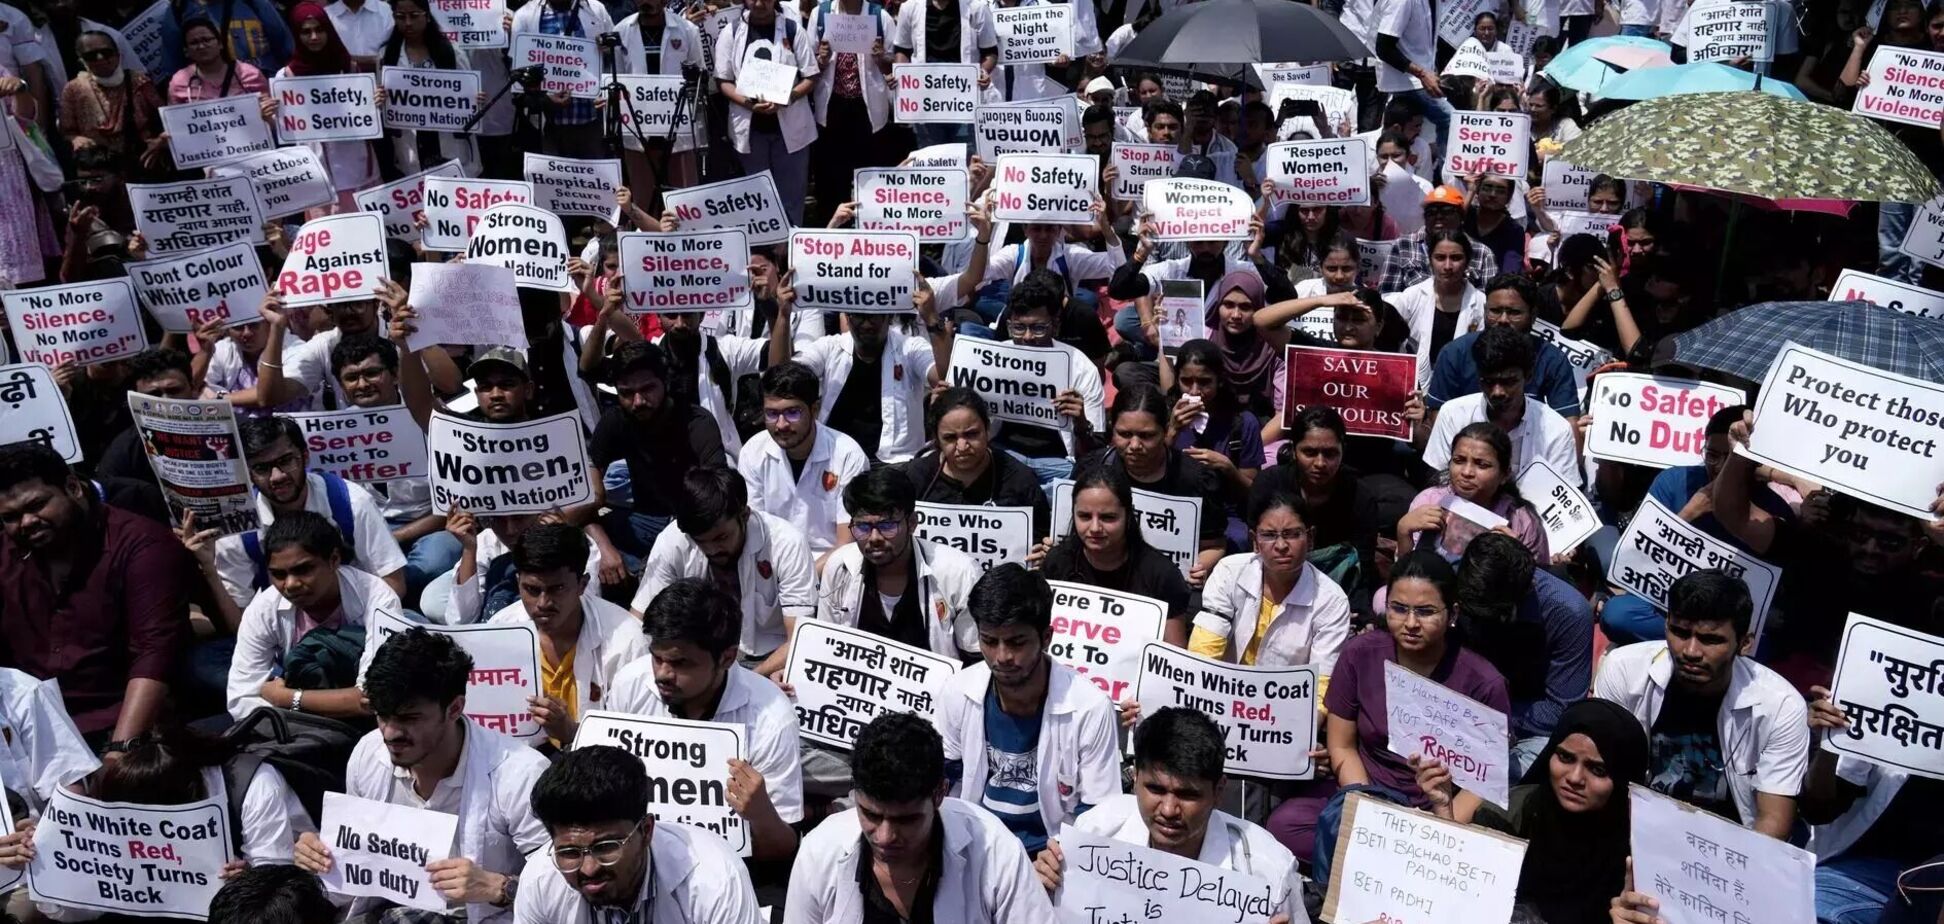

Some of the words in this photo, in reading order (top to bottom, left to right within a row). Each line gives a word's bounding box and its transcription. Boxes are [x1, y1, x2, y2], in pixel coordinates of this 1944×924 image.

[996, 11, 1045, 23] Reclaim
[1047, 9, 1064, 21] the
[1012, 22, 1049, 37] Night
[1694, 21, 1743, 36] राहणार
[531, 38, 553, 49] "No
[556, 40, 584, 52] More
[1007, 37, 1034, 47] Save
[1037, 35, 1056, 45] our
[527, 50, 588, 69] Silence,
[1004, 47, 1061, 61] Saviours
[1895, 54, 1918, 67] "No
[552, 67, 581, 78] More
[403, 74, 462, 92] "Strong
[901, 76, 920, 89] No
[924, 75, 972, 94] Safety,
[282, 90, 305, 106] No
[310, 87, 367, 106] Safety,
[388, 89, 477, 114] Women,
[1886, 85, 1905, 97] No
[1908, 89, 1943, 104] More
[191, 104, 235, 119] Justice
[900, 99, 919, 112] No
[923, 97, 974, 112] Service
[187, 116, 247, 136] Delayed
[284, 115, 306, 131] No
[312, 113, 373, 130] Service
[387, 109, 426, 126] Strong
[1460, 115, 1488, 127] Here
[1492, 117, 1513, 128] To
[215, 135, 227, 144] is
[1459, 127, 1512, 143] Serve
[179, 148, 223, 164] Justice
[226, 139, 269, 155] Denied
[1284, 144, 1346, 159] "Respect
[1462, 144, 1483, 155] Not
[1487, 145, 1507, 156] To
[272, 154, 310, 173] those
[548, 161, 595, 175] Secure
[1130, 165, 1163, 177] Stand
[1282, 160, 1348, 176] Women,
[1450, 156, 1519, 175] Suffer
[264, 169, 313, 195] protect
[532, 172, 617, 194] Hospitals,
[878, 173, 906, 186] "No
[910, 173, 946, 186] More
[1005, 167, 1025, 183] No
[1030, 166, 1088, 190] Safety,
[1167, 181, 1231, 193] "Respect
[1293, 176, 1338, 189] Reject
[202, 183, 232, 200] शांत
[264, 192, 290, 210] you
[427, 189, 449, 208] No
[555, 188, 601, 201] Secure
[875, 188, 950, 207] Silence,
[1165, 191, 1234, 206] Women,
[1273, 187, 1361, 202] Violence!"
[364, 200, 391, 216] No
[551, 199, 612, 216] Futures
[675, 203, 702, 222] No
[708, 191, 769, 217] Safety,
[1000, 192, 1021, 210] No
[1027, 193, 1089, 212] Service
[1545, 198, 1586, 209] Justice
[143, 203, 213, 224] राहणार
[883, 208, 902, 219] No
[907, 208, 943, 219] More
[1175, 206, 1222, 218] Reject
[438, 219, 460, 237] No
[484, 210, 548, 234] "Strong
[1154, 218, 1246, 236] Violence!"
[467, 233, 567, 264] Women,
[645, 240, 678, 252] "No
[681, 239, 723, 251] More
[794, 237, 845, 260] "Stop
[850, 238, 913, 259] Abuse,
[141, 267, 181, 286] Dont
[185, 252, 245, 279] Colour
[304, 248, 383, 273] Against
[642, 256, 730, 273] Silence,
[816, 262, 861, 279] Stand
[868, 263, 891, 279] for
[143, 281, 202, 308] White
[207, 271, 259, 298] Apron
[279, 270, 363, 298] Rape
[653, 275, 678, 288] No
[680, 274, 721, 287] More
[20, 294, 53, 310] "No
[58, 289, 104, 306] More
[631, 287, 745, 307] Violence!"
[801, 285, 908, 306] Justice!"
[22, 307, 116, 332] Silence,
[36, 332, 58, 347] No
[63, 326, 109, 343] More
[973, 346, 1047, 377] "Strong
[1323, 356, 1378, 376] SAVE
[1323, 382, 1369, 399] OUR
[1786, 364, 1881, 411] Protect
[305, 416, 358, 433] Here
[364, 412, 389, 426] To
[1783, 392, 1838, 428] Who
[1838, 419, 1937, 459] protect
[308, 430, 394, 452] Serve
[452, 428, 549, 455] "Strong
[1609, 421, 1640, 446] No
[319, 451, 358, 466] Not
[364, 448, 389, 460] To
[1819, 443, 1870, 471] you
[435, 450, 582, 487] Women,
[436, 485, 497, 511] Strong
[500, 477, 583, 508] Nation!"
[958, 514, 1003, 529] Who
[1099, 597, 1125, 616] To
[1083, 644, 1109, 665] To
[803, 658, 893, 701] राहणार
[888, 656, 930, 684] शांत
[1148, 652, 1196, 686] When
[1200, 670, 1258, 698] White
[1263, 679, 1310, 700] Coat
[1231, 700, 1276, 726] Red,
[1391, 705, 1421, 728] NOT
[1237, 723, 1294, 746] Turns
[86, 810, 153, 837] White
[159, 816, 219, 841] Coat
[1381, 811, 1417, 836] THEY
[60, 829, 123, 859] Turns
[127, 841, 183, 866] Red,
[336, 823, 362, 851] No
[367, 832, 431, 868] Safety
[1355, 826, 1388, 850] BETI
[1457, 861, 1498, 886] BETI
[1723, 846, 1750, 871] हम
[54, 850, 135, 884] Society
[141, 864, 209, 887] Turns
[345, 862, 373, 887] No
[378, 867, 420, 900] duty
[1078, 844, 1169, 892] Justice
[1179, 866, 1272, 924] Delayed
[1354, 871, 1384, 895] BETI
[97, 880, 165, 905] Black
[1144, 898, 1163, 920] is
